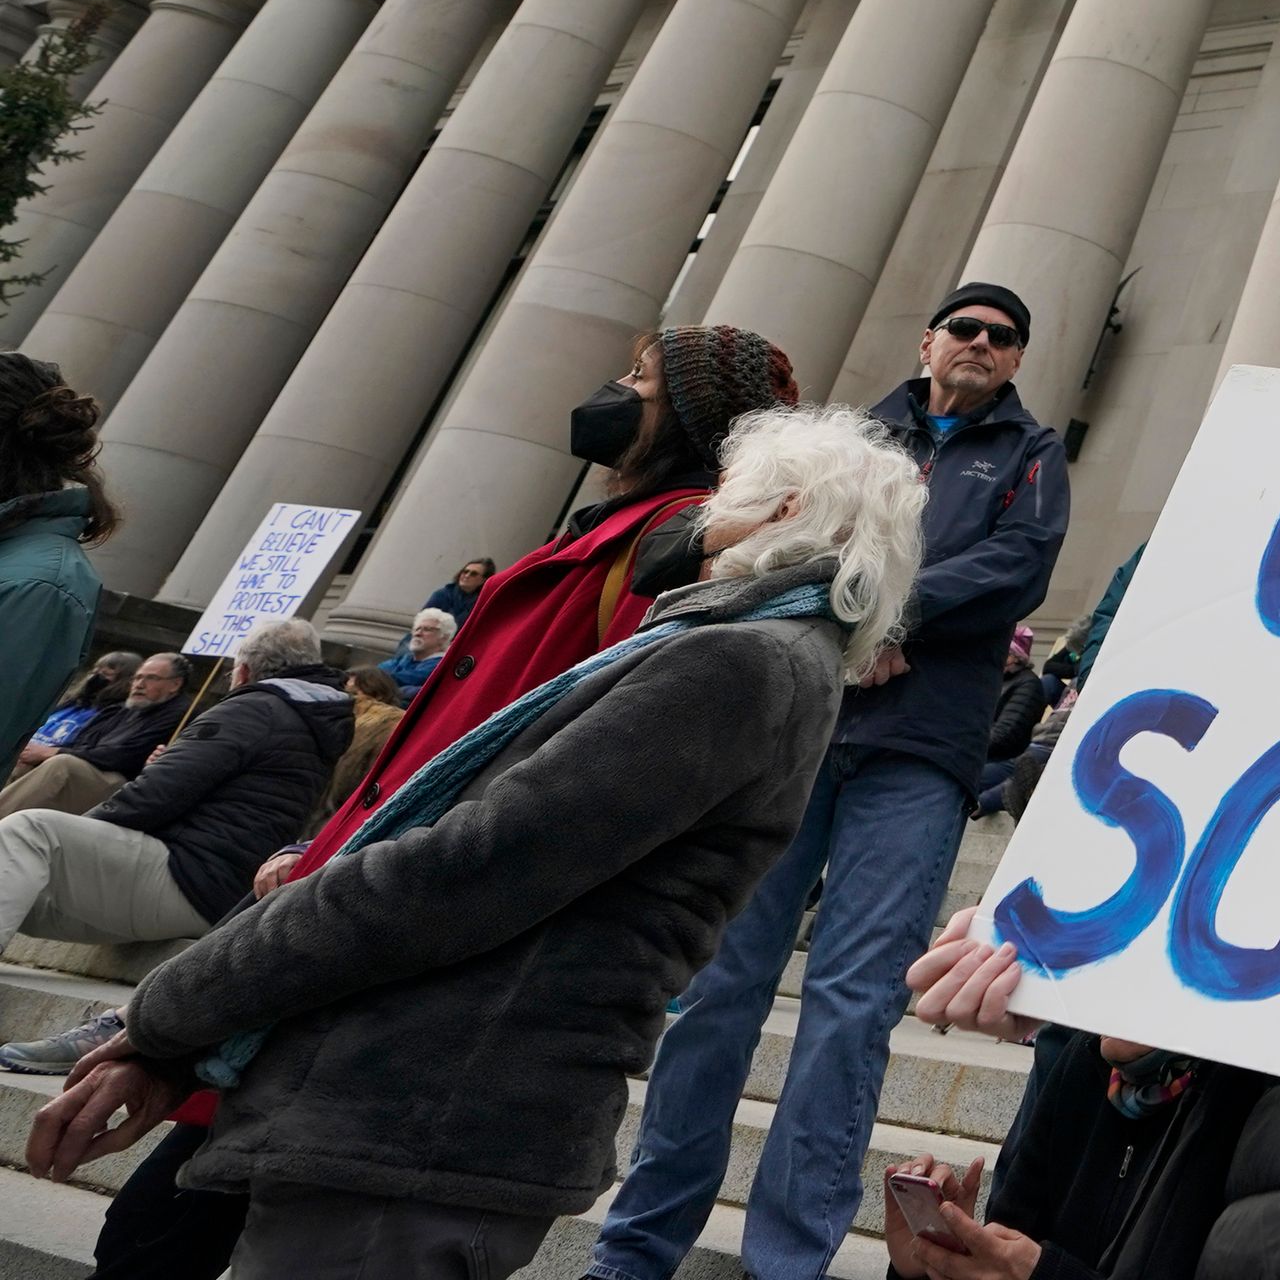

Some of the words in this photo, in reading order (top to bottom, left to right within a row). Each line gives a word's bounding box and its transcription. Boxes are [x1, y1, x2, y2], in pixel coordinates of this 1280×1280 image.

[270, 506, 287, 526] I
[290, 509, 353, 533] CAN'T
[259, 532, 326, 554] BELIEVE
[239, 554, 263, 571] WE
[260, 555, 302, 572] STILL
[235, 573, 273, 590] HAVE
[276, 574, 297, 590] TO
[227, 591, 302, 615] PROTEST
[223, 615, 256, 632] THIS
